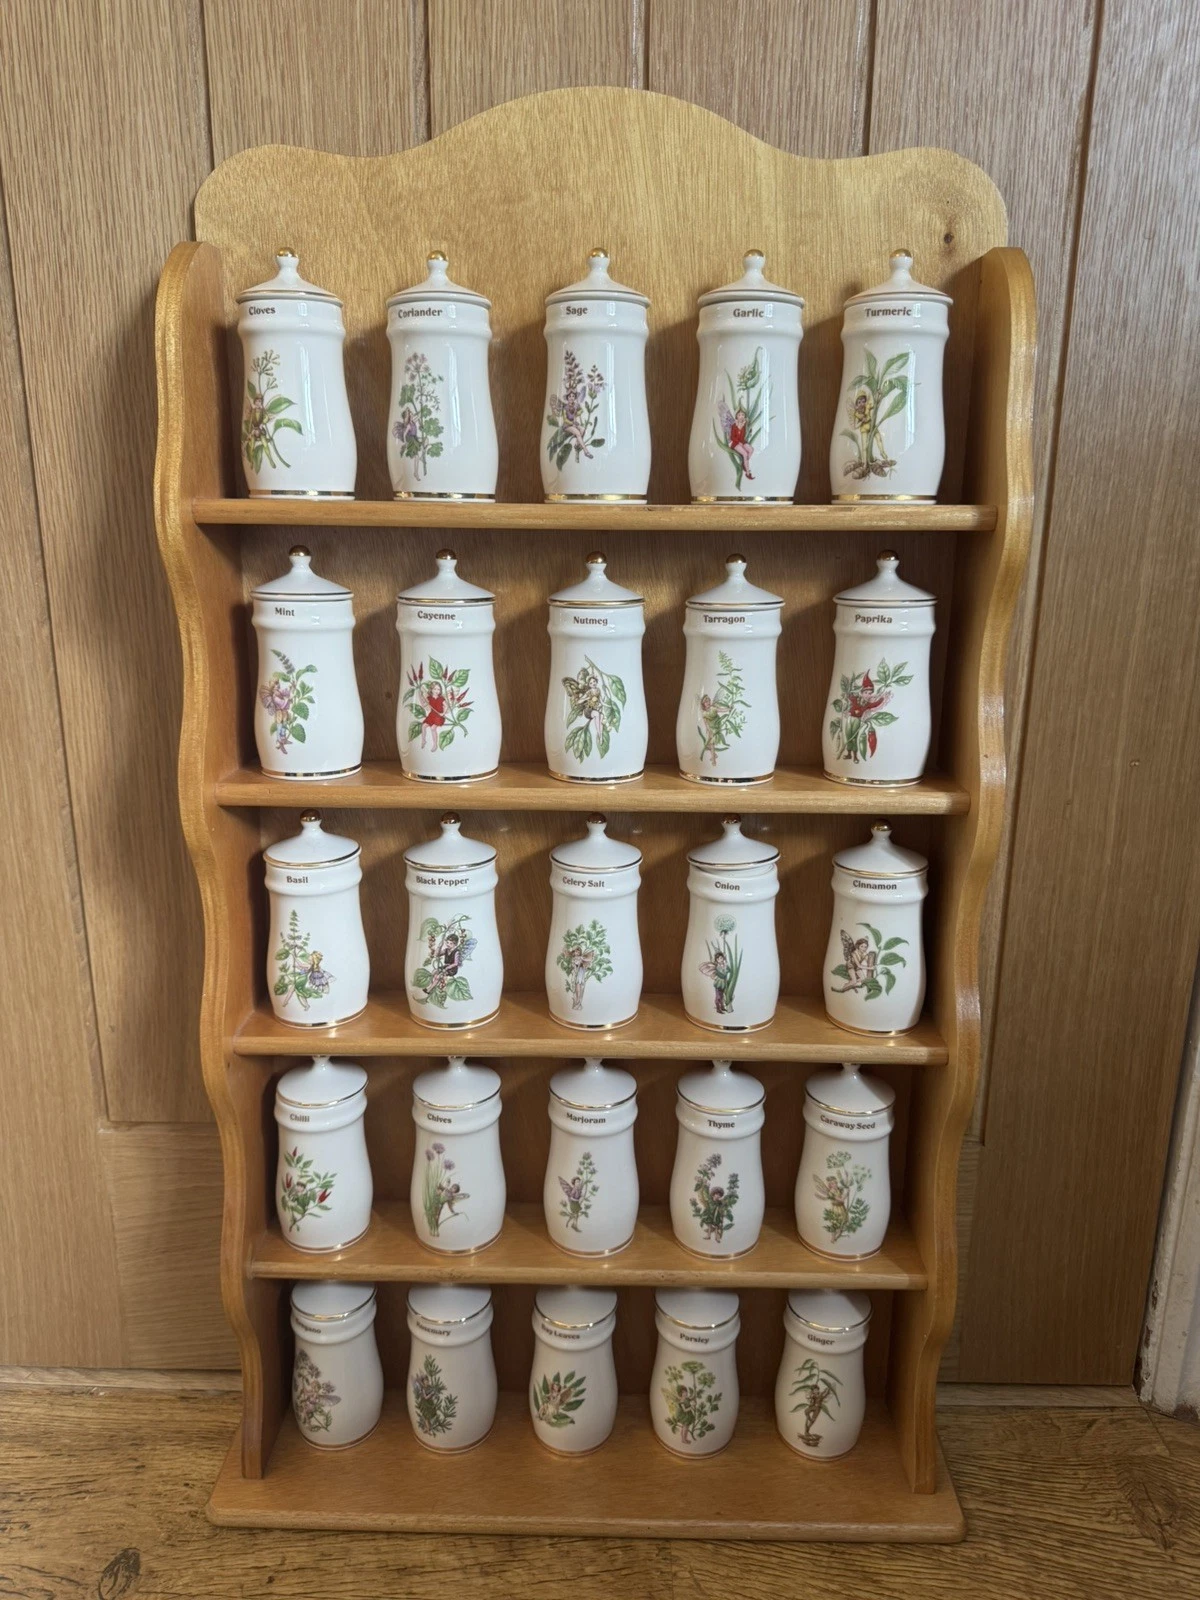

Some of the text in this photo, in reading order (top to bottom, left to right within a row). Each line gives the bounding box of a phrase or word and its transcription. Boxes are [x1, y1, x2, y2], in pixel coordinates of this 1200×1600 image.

[249, 306, 276, 315] Cloves
[398, 308, 443, 318] Coriander
[566, 306, 588, 316] Sage
[733, 309, 764, 317] Garlic
[865, 307, 912, 317] Turmeric
[275, 607, 295, 616] Mint
[417, 611, 456, 621] Cayenne
[573, 616, 608, 626] Nutmeg
[703, 615, 745, 624] Tarragon
[855, 614, 892, 623] Paprika
[416, 876, 469, 886] Black Pepper
[563, 877, 586, 887] Celery
[715, 881, 740, 890] Onion
[853, 880, 897, 890] Cinnamon
[290, 1114, 309, 1122] Chilli
[427, 1113, 452, 1124] Chives
[566, 1112, 606, 1124] Marjoram
[820, 1115, 855, 1130] Caraway
[707, 1120, 735, 1129] Thyme
[680, 1333, 709, 1344] Parsley
[807, 1334, 835, 1345] Ginger
